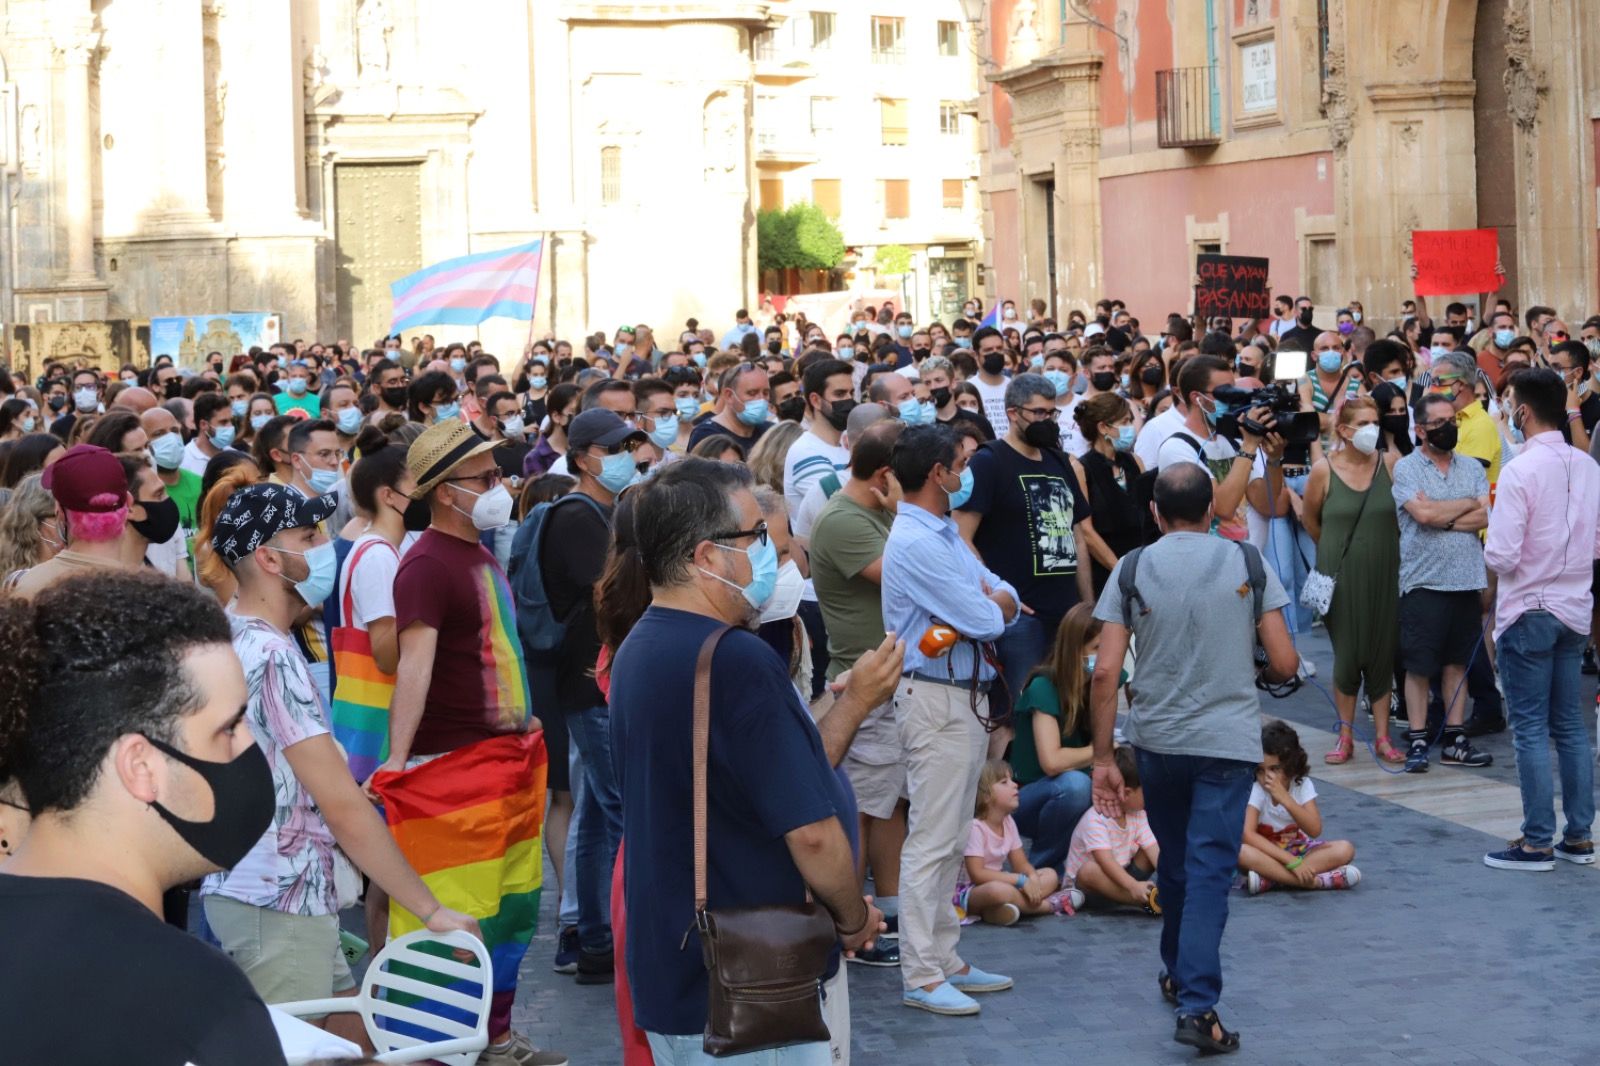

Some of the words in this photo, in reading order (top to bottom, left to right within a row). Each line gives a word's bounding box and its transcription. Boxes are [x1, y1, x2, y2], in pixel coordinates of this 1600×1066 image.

[1200, 262, 1228, 279] QUE
[1230, 264, 1266, 281] VAYAN
[1197, 287, 1270, 309] PASANDO
[233, 509, 252, 527] SPORT
[263, 505, 278, 523] PORT
[247, 529, 261, 551] SPORT
